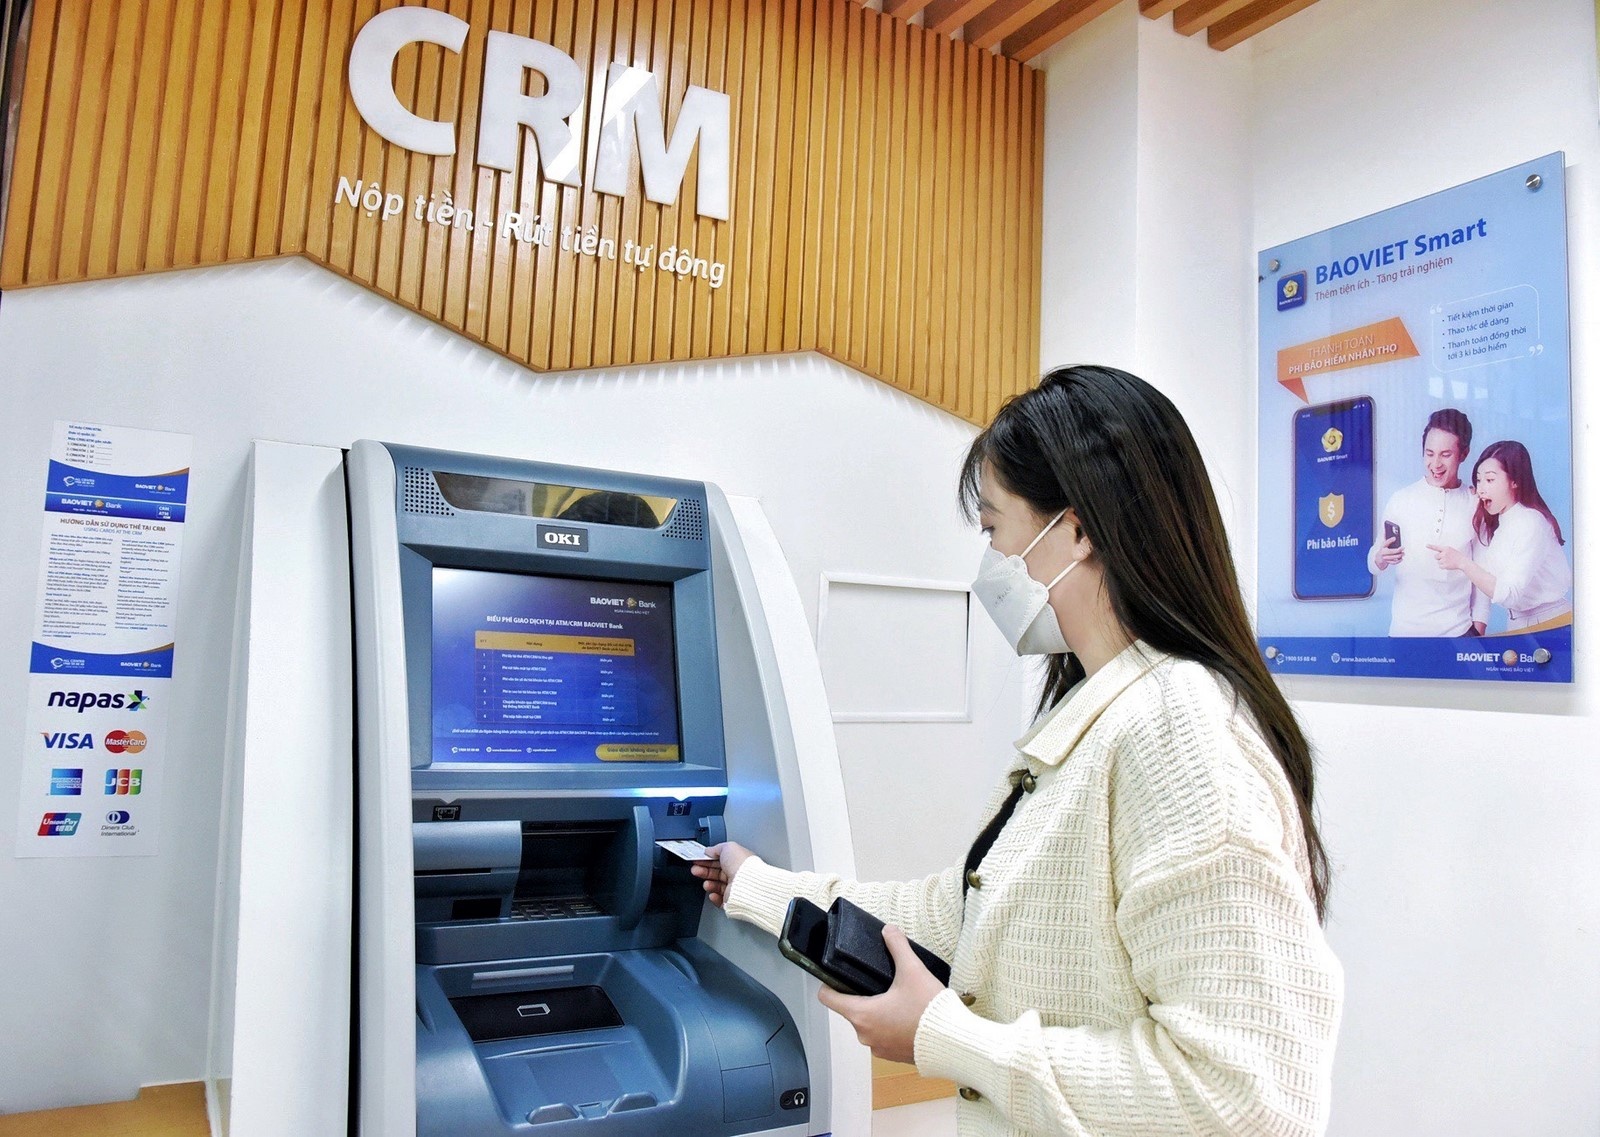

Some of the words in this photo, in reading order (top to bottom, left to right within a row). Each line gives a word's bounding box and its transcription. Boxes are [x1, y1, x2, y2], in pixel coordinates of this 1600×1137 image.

[349, 6, 730, 221] CRM
[335, 176, 404, 221] Nộp
[414, 189, 474, 231] tiền
[502, 212, 552, 247] Rút
[561, 225, 615, 260] tiền
[624, 239, 653, 272] tự
[658, 245, 725, 289] động
[1315, 240, 1409, 285] BAOVIET
[1414, 218, 1487, 256] Smart
[1315, 288, 1338, 302] Thêm
[1339, 282, 1356, 296] tiện
[1357, 277, 1370, 291] ích
[1376, 271, 1398, 285] Tăng
[1399, 265, 1415, 277] trải
[1416, 256, 1453, 274] nghiệm
[1447, 314, 1460, 322] Tiết
[1461, 310, 1480, 319] kiệm
[1497, 301, 1514, 312] gian
[1447, 327, 1466, 336] Thao
[1490, 317, 1510, 327] dàng
[1308, 341, 1343, 358] THANH
[1447, 338, 1470, 350] Thanh
[1288, 364, 1303, 374] PHÍ
[1348, 349, 1375, 362] NHÂN
[1377, 343, 1398, 355] THỌ
[61, 498, 93, 507] BAOVIET
[545, 532, 580, 546] OKI
[1306, 538, 1320, 550] Phí
[1320, 537, 1336, 549] bảo
[1337, 534, 1359, 547] hiểm
[590, 597, 624, 606] BAOVIET
[638, 600, 657, 608] Bank
[513, 616, 529, 624] GIAO
[555, 619, 583, 627] ATM/CRM
[583, 621, 608, 629] BAOVIET
[1456, 652, 1500, 662] BAOVIET
[47, 691, 125, 713] napas
[40, 732, 94, 749] VISA
[105, 736, 147, 746] MasterCard
[105, 778, 140, 786] JCB
[43, 818, 78, 827] UnionPay
